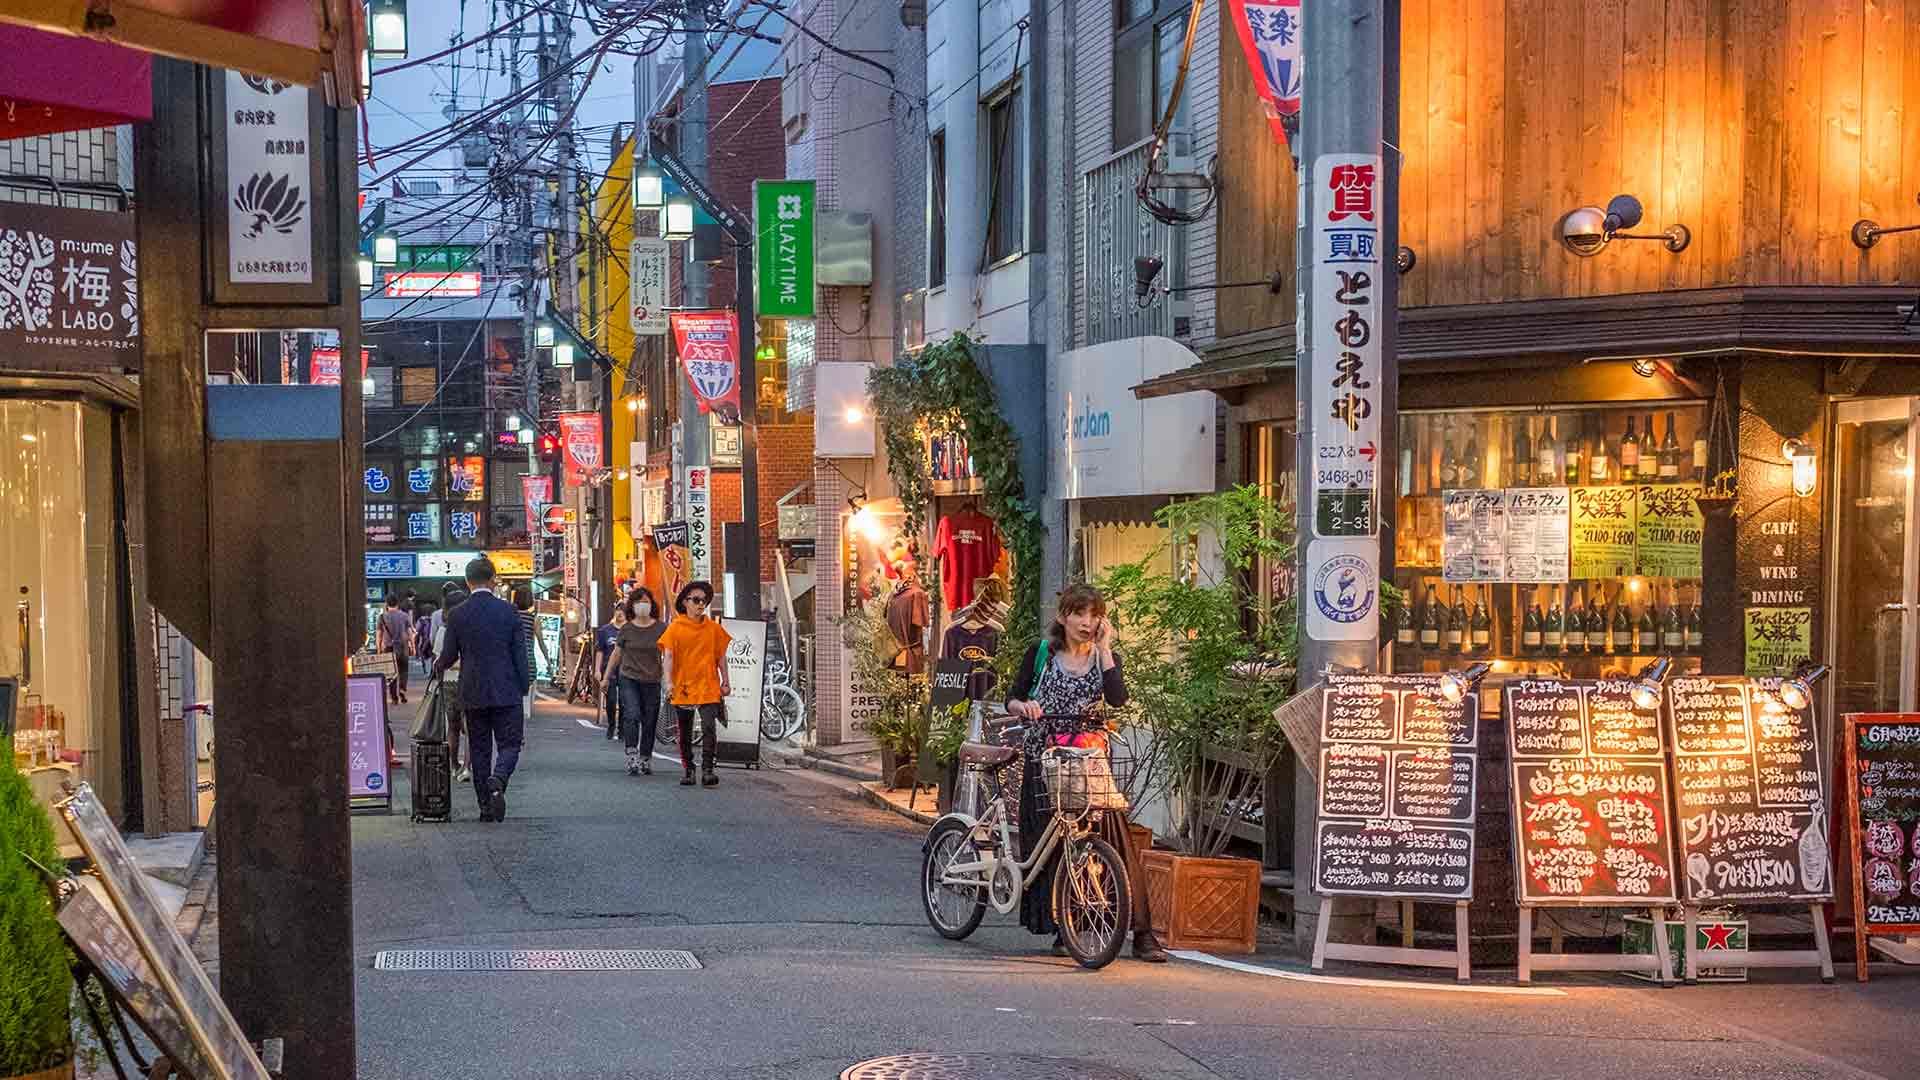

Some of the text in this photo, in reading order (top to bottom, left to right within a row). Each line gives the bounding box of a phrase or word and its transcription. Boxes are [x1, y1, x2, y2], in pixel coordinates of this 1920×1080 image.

[1328, 164, 1376, 222] 質
[1330, 233, 1375, 258] 買取
[779, 223, 797, 305] LAZYTIME
[61, 257, 112, 308] 梅
[61, 310, 114, 331] LABO
[1319, 446, 1356, 459] ここ入る
[1578, 502, 1627, 518] 大募集
[1643, 501, 1695, 518] 大募集
[407, 511, 478, 538] 歯科
[1773, 545, 1785, 557] &
[1759, 566, 1799, 580] WINE
[1751, 590, 1804, 604] DINING
[1752, 625, 1803, 642] 大募集
[934, 672, 969, 689] PRESALE
[1520, 681, 1564, 694] PIZZA
